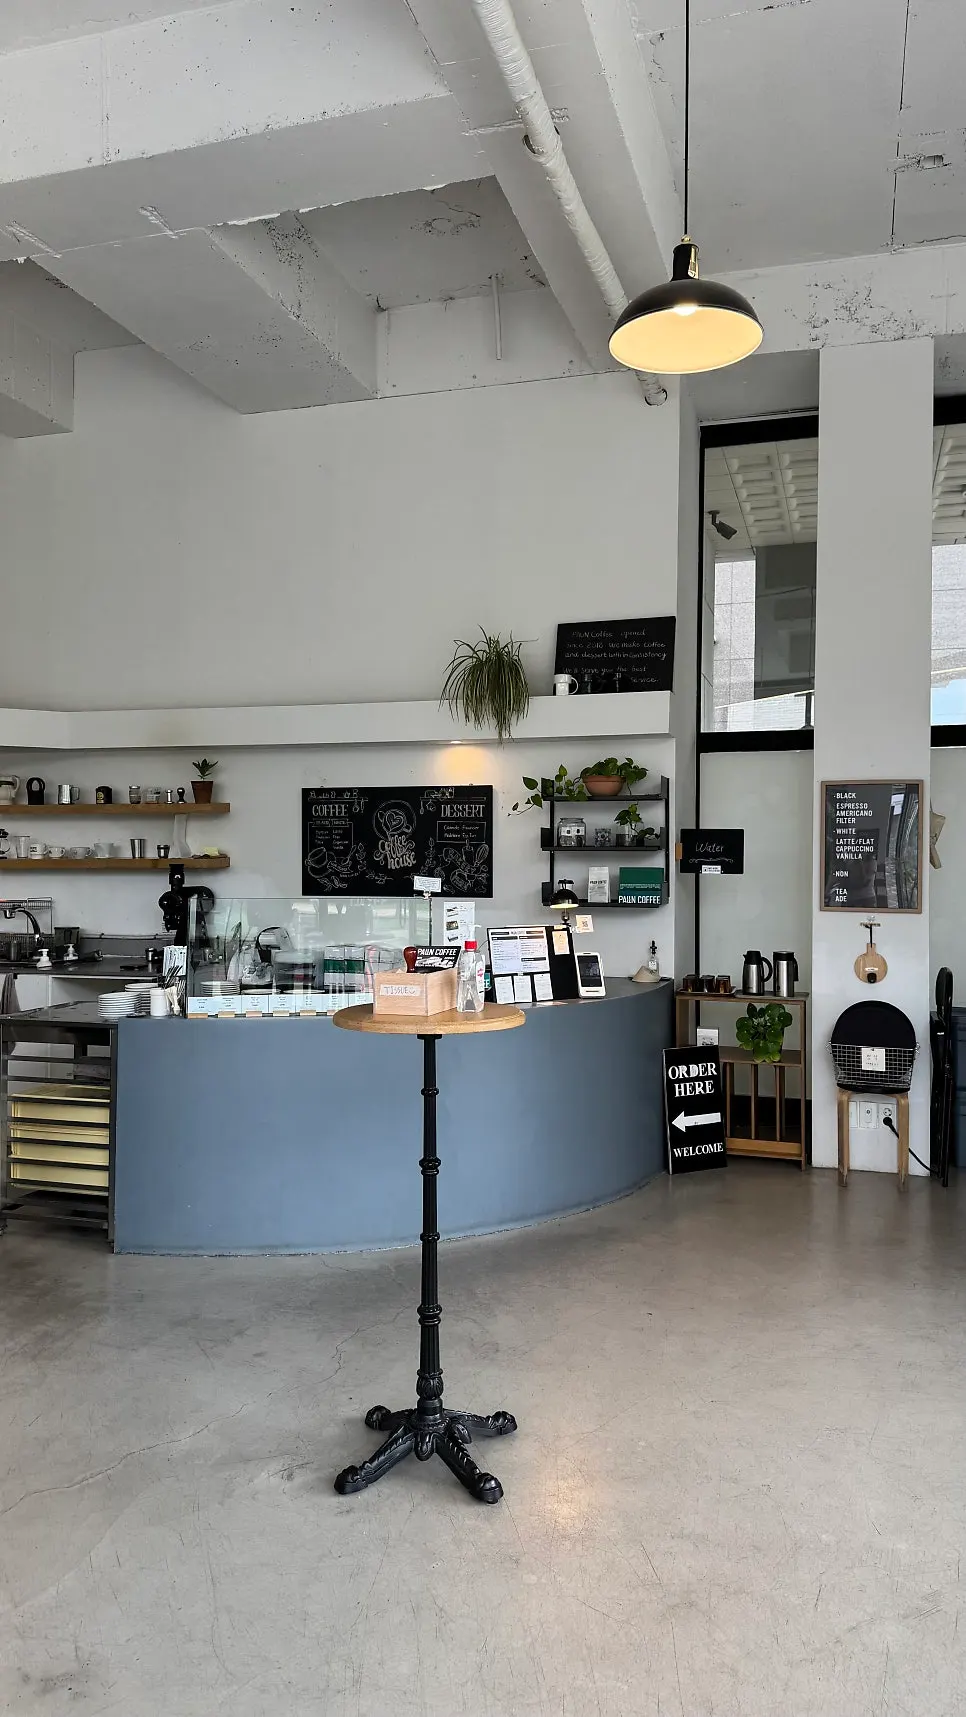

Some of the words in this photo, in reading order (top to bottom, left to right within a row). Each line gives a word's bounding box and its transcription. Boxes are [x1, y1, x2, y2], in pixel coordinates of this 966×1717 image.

[312, 804, 348, 817] COFFEE
[441, 804, 486, 817] DESSERT
[387, 852, 416, 869] house
[637, 895, 661, 904] COFFEE
[435, 948, 458, 956] COFFEE
[383, 986, 409, 995] TISSUE
[668, 1062, 717, 1080] ORDER
[674, 1080, 714, 1097] HERE
[673, 1142, 724, 1158] WELCOME
